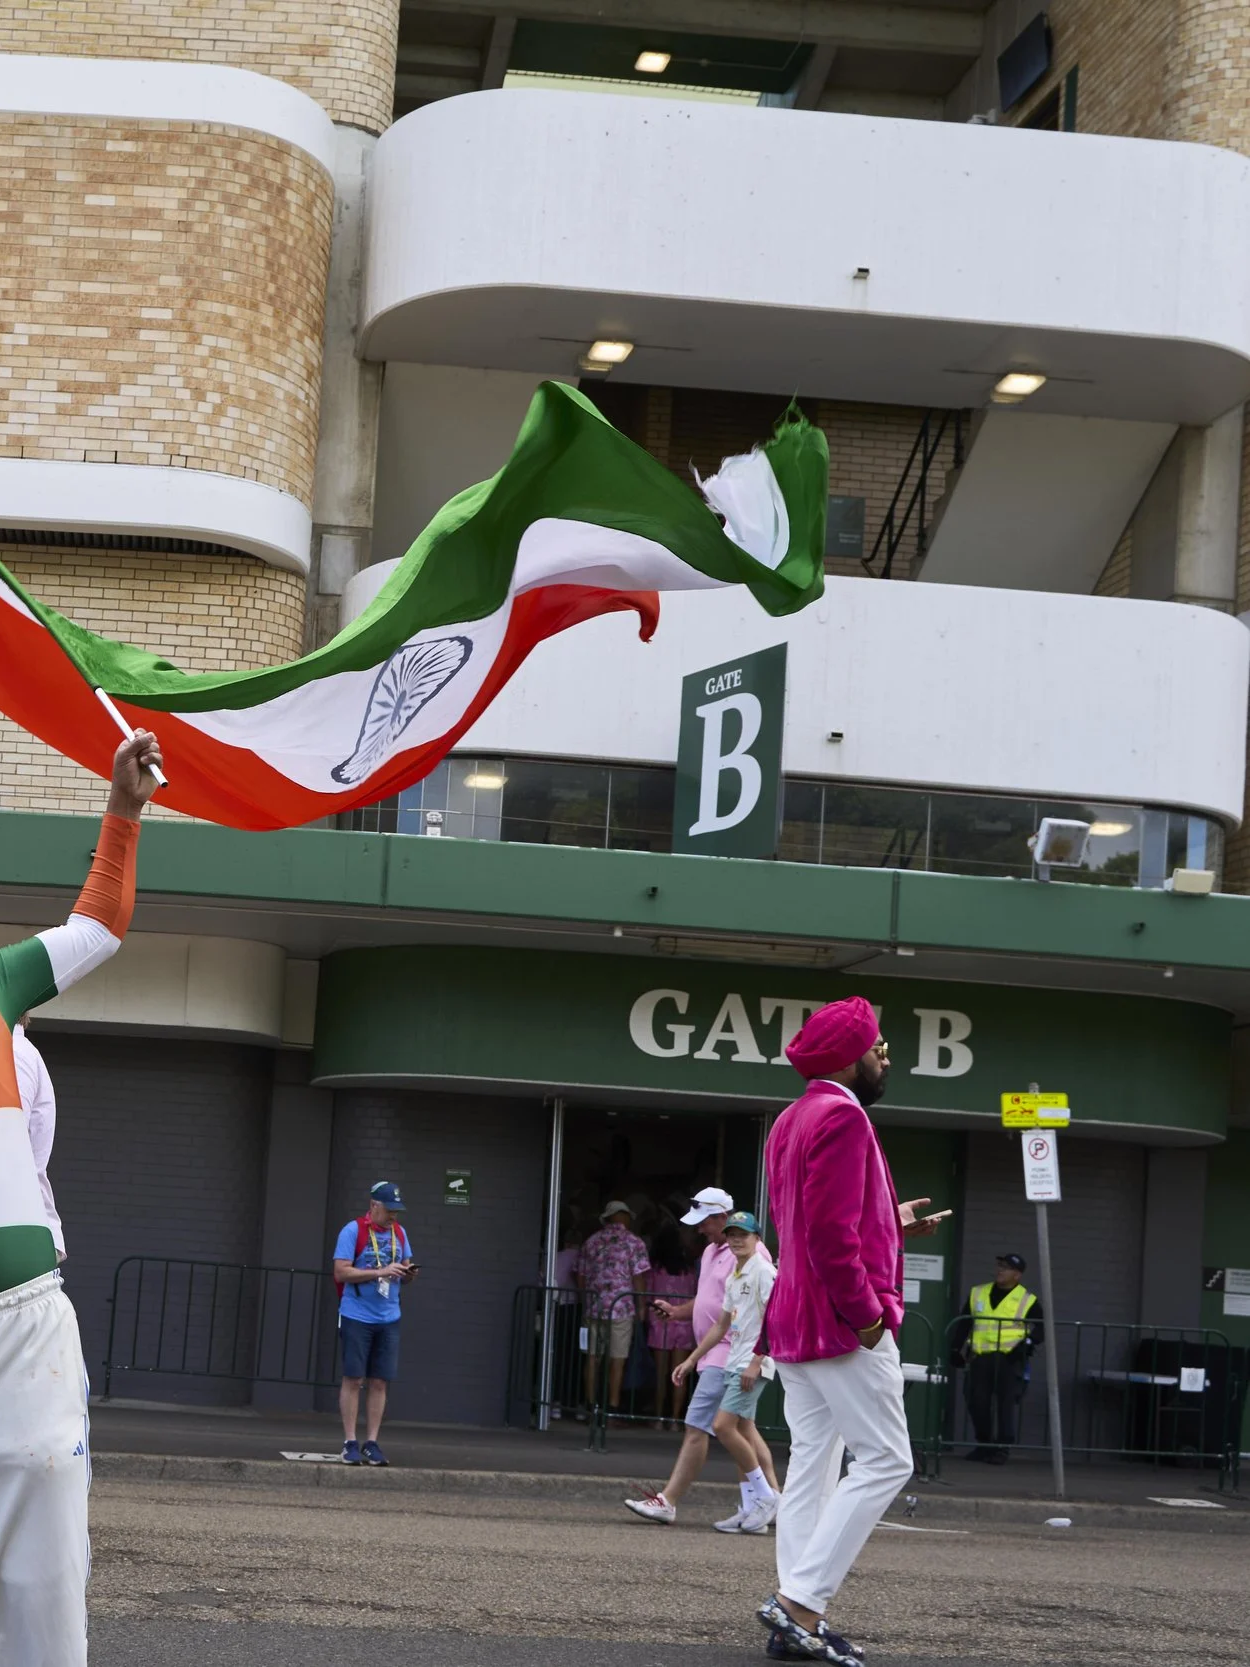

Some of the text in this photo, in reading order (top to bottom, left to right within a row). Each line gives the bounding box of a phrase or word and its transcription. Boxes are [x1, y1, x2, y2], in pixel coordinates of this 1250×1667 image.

[705, 669, 742, 695] GATE
[689, 692, 762, 836] B
[629, 988, 974, 1077] GAT B
